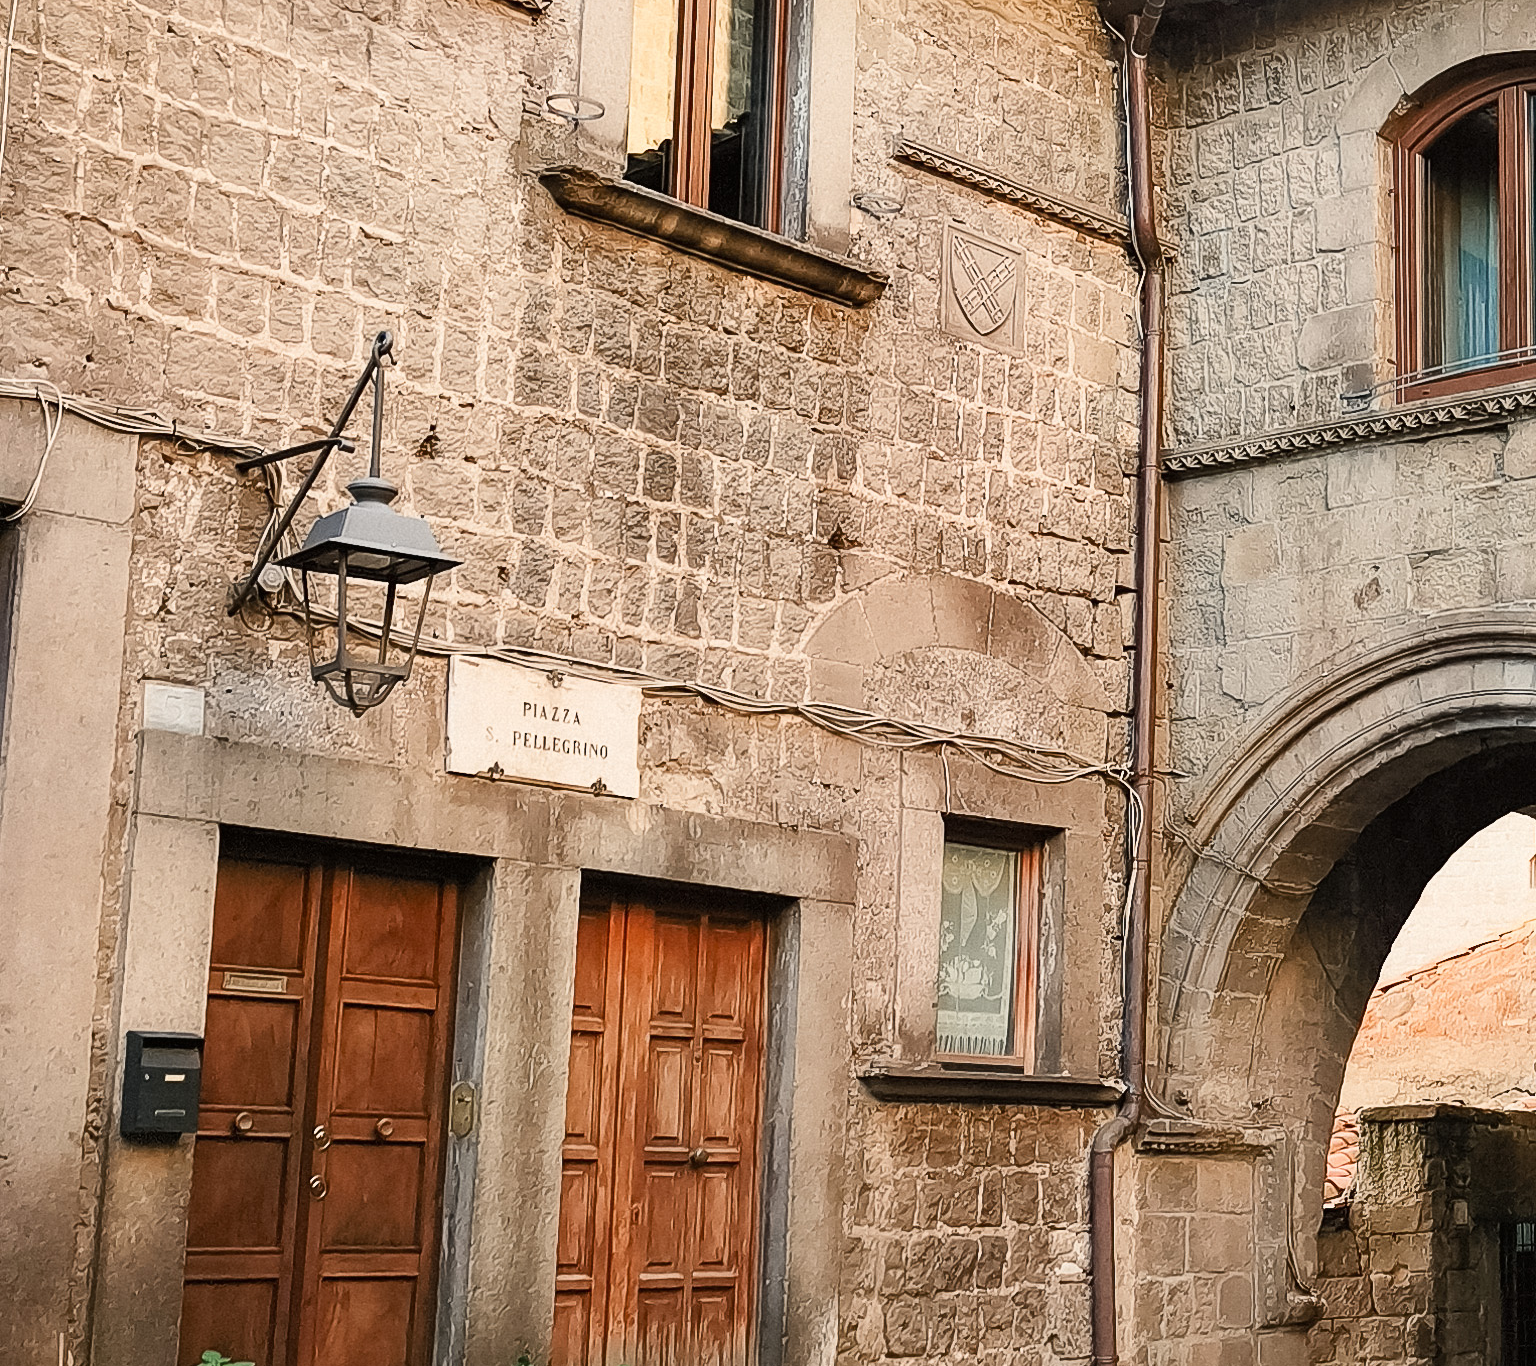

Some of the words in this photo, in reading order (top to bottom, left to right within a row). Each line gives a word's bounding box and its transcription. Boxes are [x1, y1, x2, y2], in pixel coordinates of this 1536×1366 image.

[163, 695, 183, 723] 5
[523, 701, 581, 726] PIAZZA
[486, 726, 499, 743] S.
[513, 731, 608, 760] PELLEGRINO
